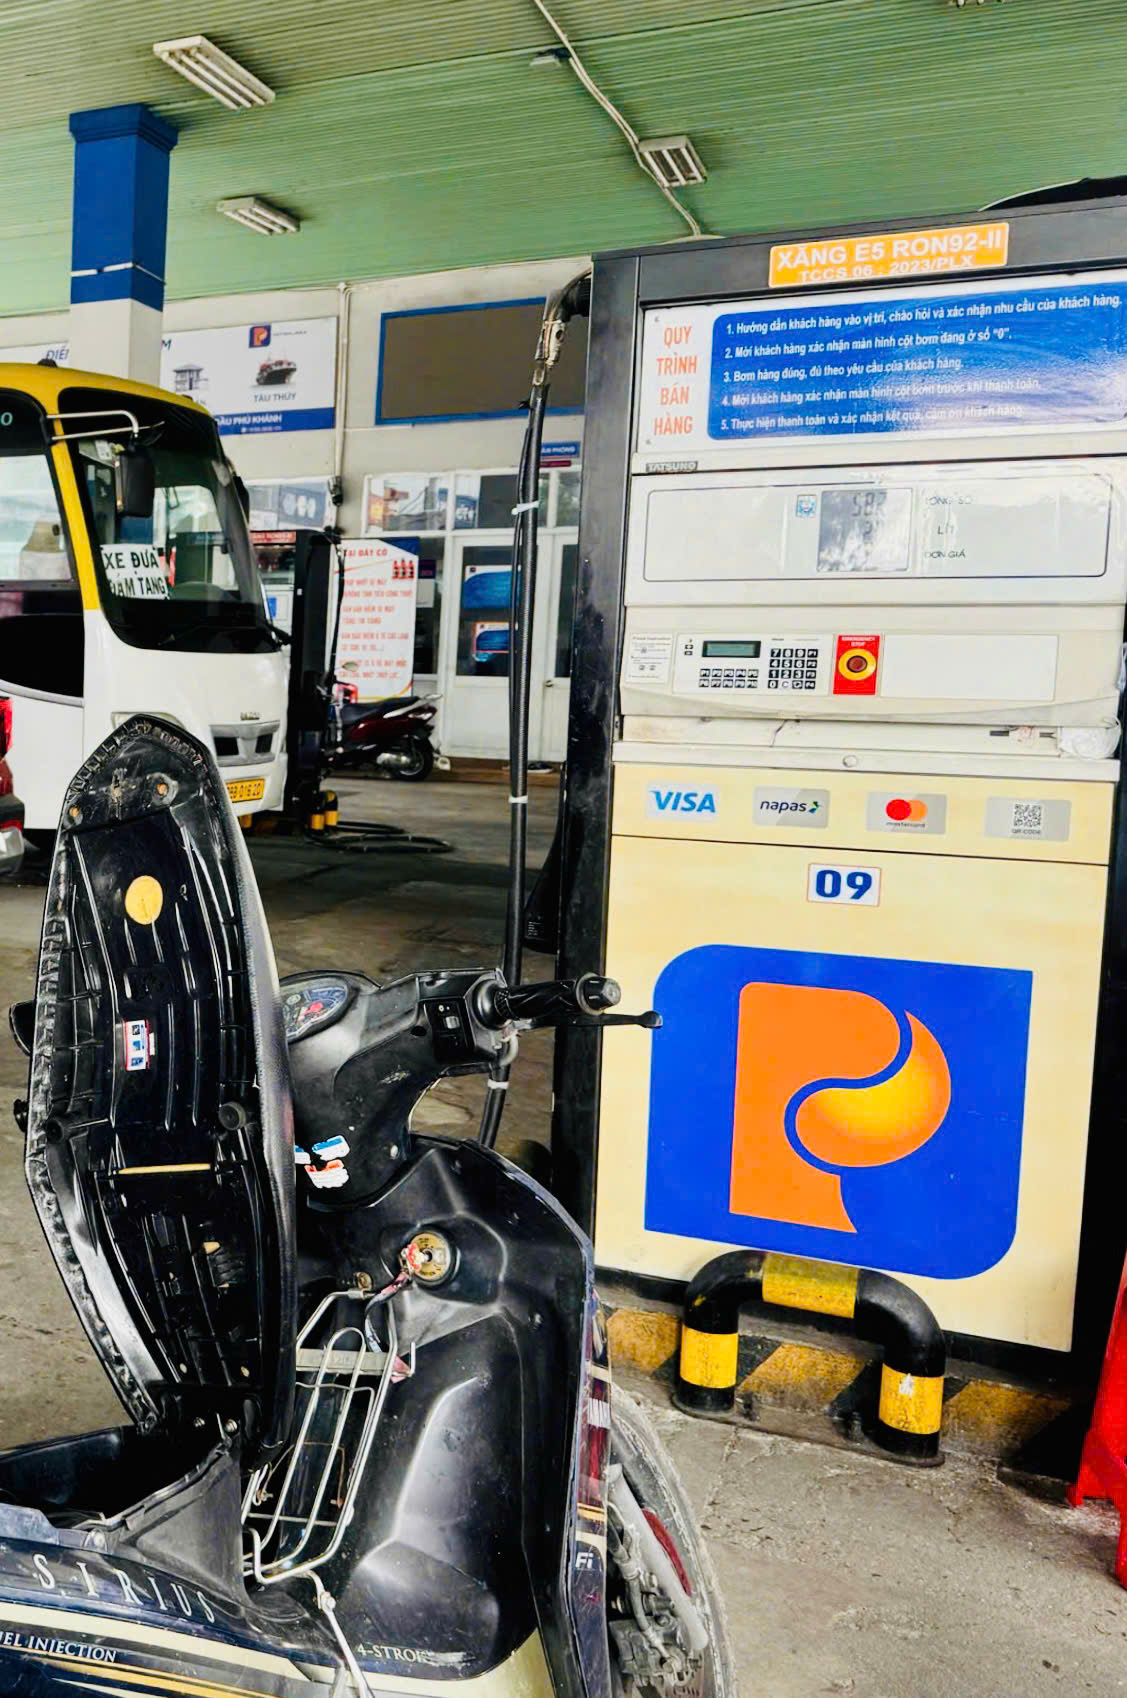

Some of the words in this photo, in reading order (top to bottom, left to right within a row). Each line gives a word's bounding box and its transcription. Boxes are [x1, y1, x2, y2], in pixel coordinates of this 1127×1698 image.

[777, 246, 847, 270] XĂNG
[855, 243, 885, 262] E5
[892, 229, 1001, 259] RON92-II
[799, 268, 848, 283] TCCS
[853, 266, 873, 278] 06
[890, 254, 974, 274] 2023/PLX
[726, 324, 734, 334] 1.
[789, 318, 816, 330] khách
[818, 316, 841, 329] hàng
[844, 315, 861, 326] vào
[889, 310, 912, 322] chào
[933, 308, 945, 319] và
[947, 306, 964, 317] xác
[967, 303, 992, 318] nhận
[994, 302, 1014, 314] nhu
[1016, 298, 1034, 312] cầu
[1037, 299, 1056, 310] của
[1059, 296, 1089, 309] khách
[1093, 294, 1122, 308] hàng.
[663, 326, 692, 348] QUY
[725, 348, 733, 359] 2.
[754, 342, 781, 356] khách
[783, 343, 806, 356] hàng
[808, 340, 824, 352] xác
[827, 339, 850, 354] nhận
[852, 337, 872, 349] màn
[874, 336, 895, 348] hình
[898, 335, 913, 347] cột
[916, 331, 938, 344] bơm
[941, 330, 965, 344] đang
[656, 351, 698, 376] TRÌNH
[724, 372, 731, 382] 3.
[734, 370, 755, 382] Bơm
[757, 368, 779, 382] hàng
[824, 364, 845, 376] theo
[847, 363, 863, 377] yêu
[866, 360, 883, 373] cầu
[905, 357, 934, 371] khách
[660, 382, 690, 406] BÁN
[752, 392, 778, 405] khách
[780, 391, 803, 404] hàng
[805, 390, 821, 401] xác
[824, 388, 847, 402] nhận
[849, 386, 868, 398] màn
[654, 412, 693, 436] HÀNG
[720, 419, 729, 430] 5.
[731, 418, 754, 431] Thực
[756, 416, 775, 430] hiện
[778, 415, 803, 428] thanh
[805, 413, 825, 426] toán
[828, 413, 839, 424] và
[841, 411, 857, 423] xác
[860, 410, 883, 424] nhận
[648, 462, 697, 473] TATSUNO
[103, 552, 124, 569] XE
[948, 548, 966, 559] GIÁ
[138, 576, 166, 596] TANG
[649, 789, 716, 814] VISA
[760, 799, 807, 814] napas
[814, 868, 873, 901] 09
[574, 1552, 594, 1569] Fi
[33, 1553, 216, 1624] SIRIUS
[27, 1633, 116, 1663] INJECTION
